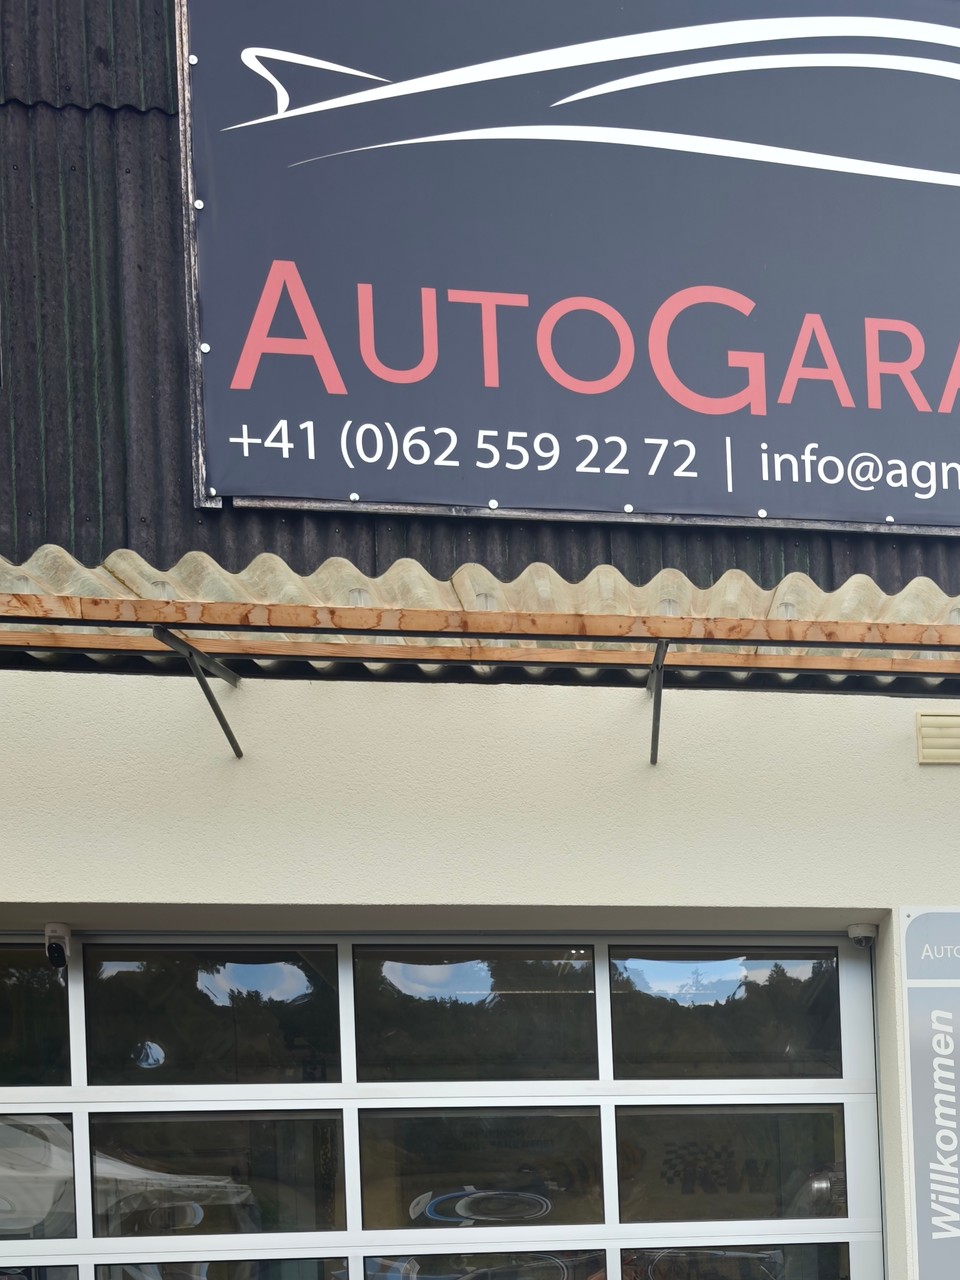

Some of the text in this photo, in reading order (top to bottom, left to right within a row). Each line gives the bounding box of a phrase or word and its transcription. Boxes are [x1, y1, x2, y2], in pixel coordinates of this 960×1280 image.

[229, 420, 316, 461] +41
[340, 421, 459, 471] (0)62
[475, 430, 560, 472] 559
[576, 435, 630, 475] 22
[644, 438, 698, 478] 72
[929, 1009, 960, 1240] Willkommen
